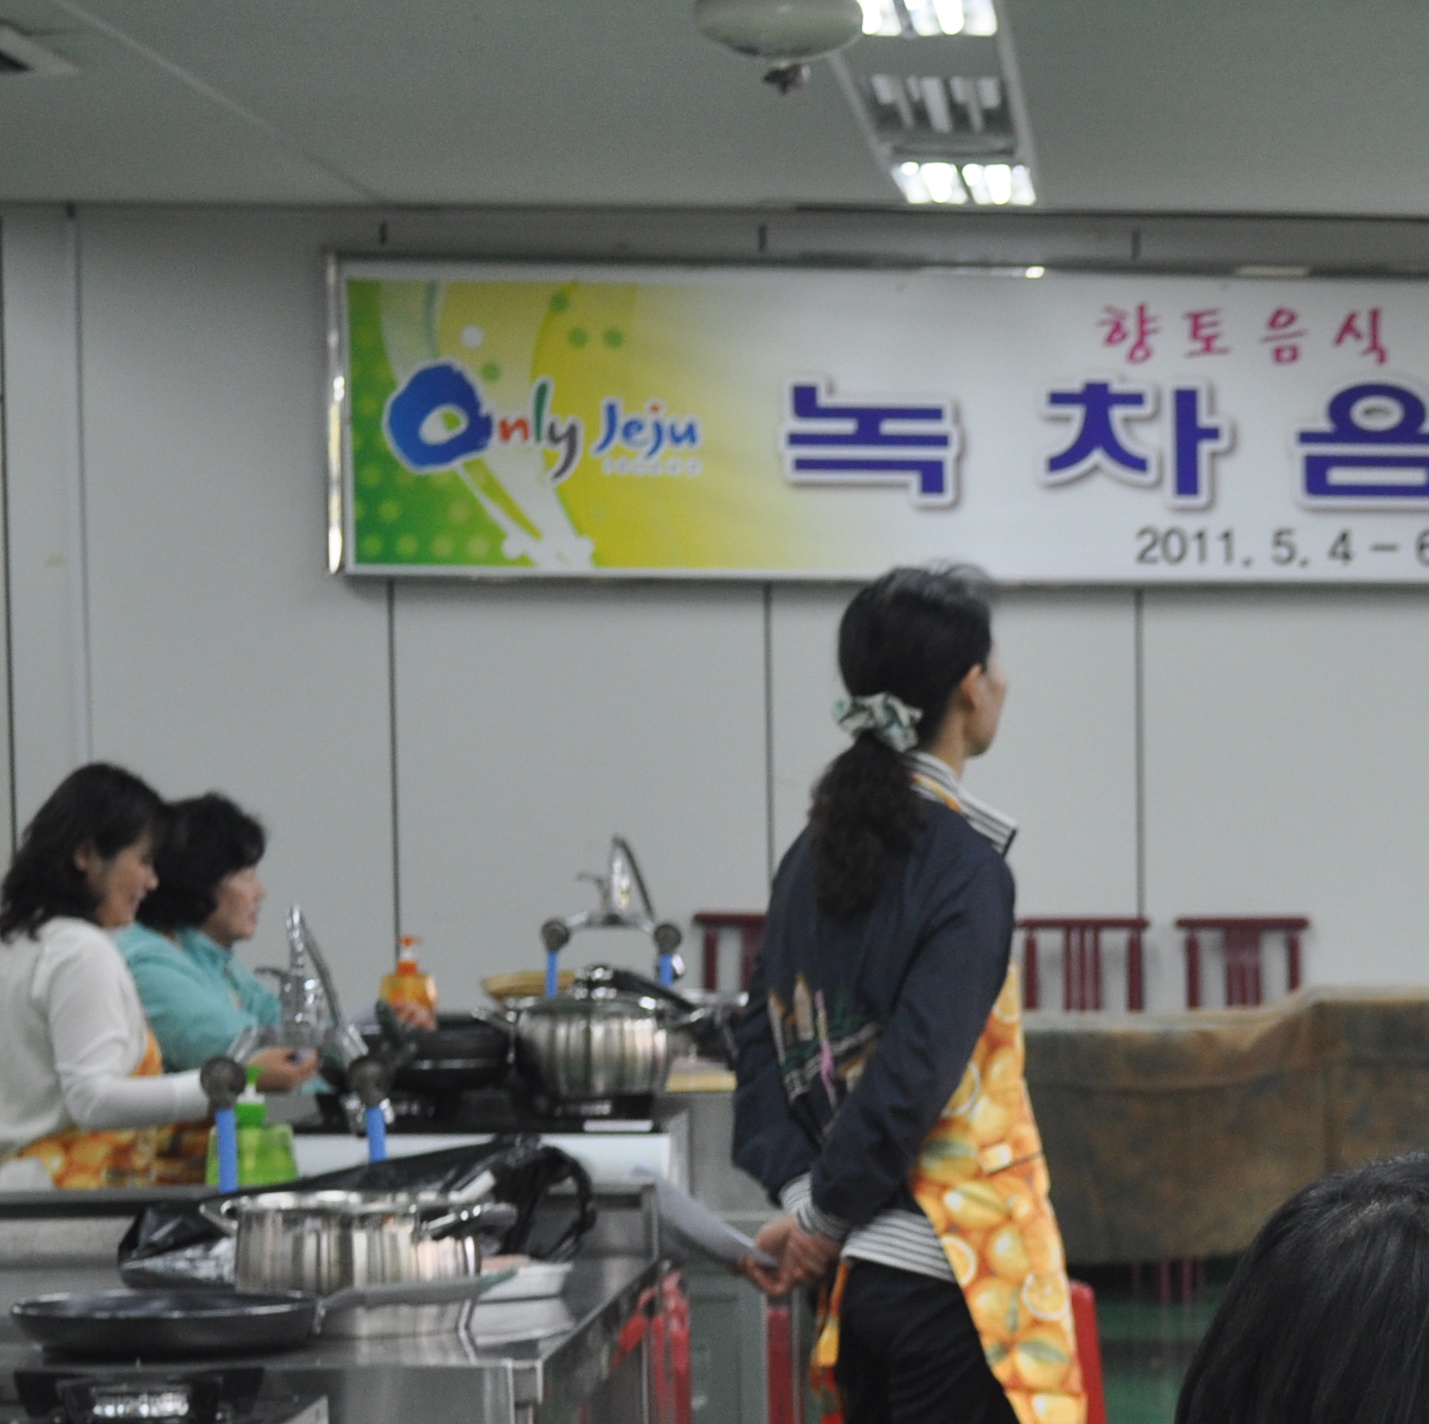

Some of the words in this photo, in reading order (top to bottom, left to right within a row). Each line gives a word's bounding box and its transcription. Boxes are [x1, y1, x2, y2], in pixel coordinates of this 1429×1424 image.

[1096, 303, 1388, 365] 향토음식
[388, 362, 578, 480] Only
[590, 402, 698, 459] Jeju
